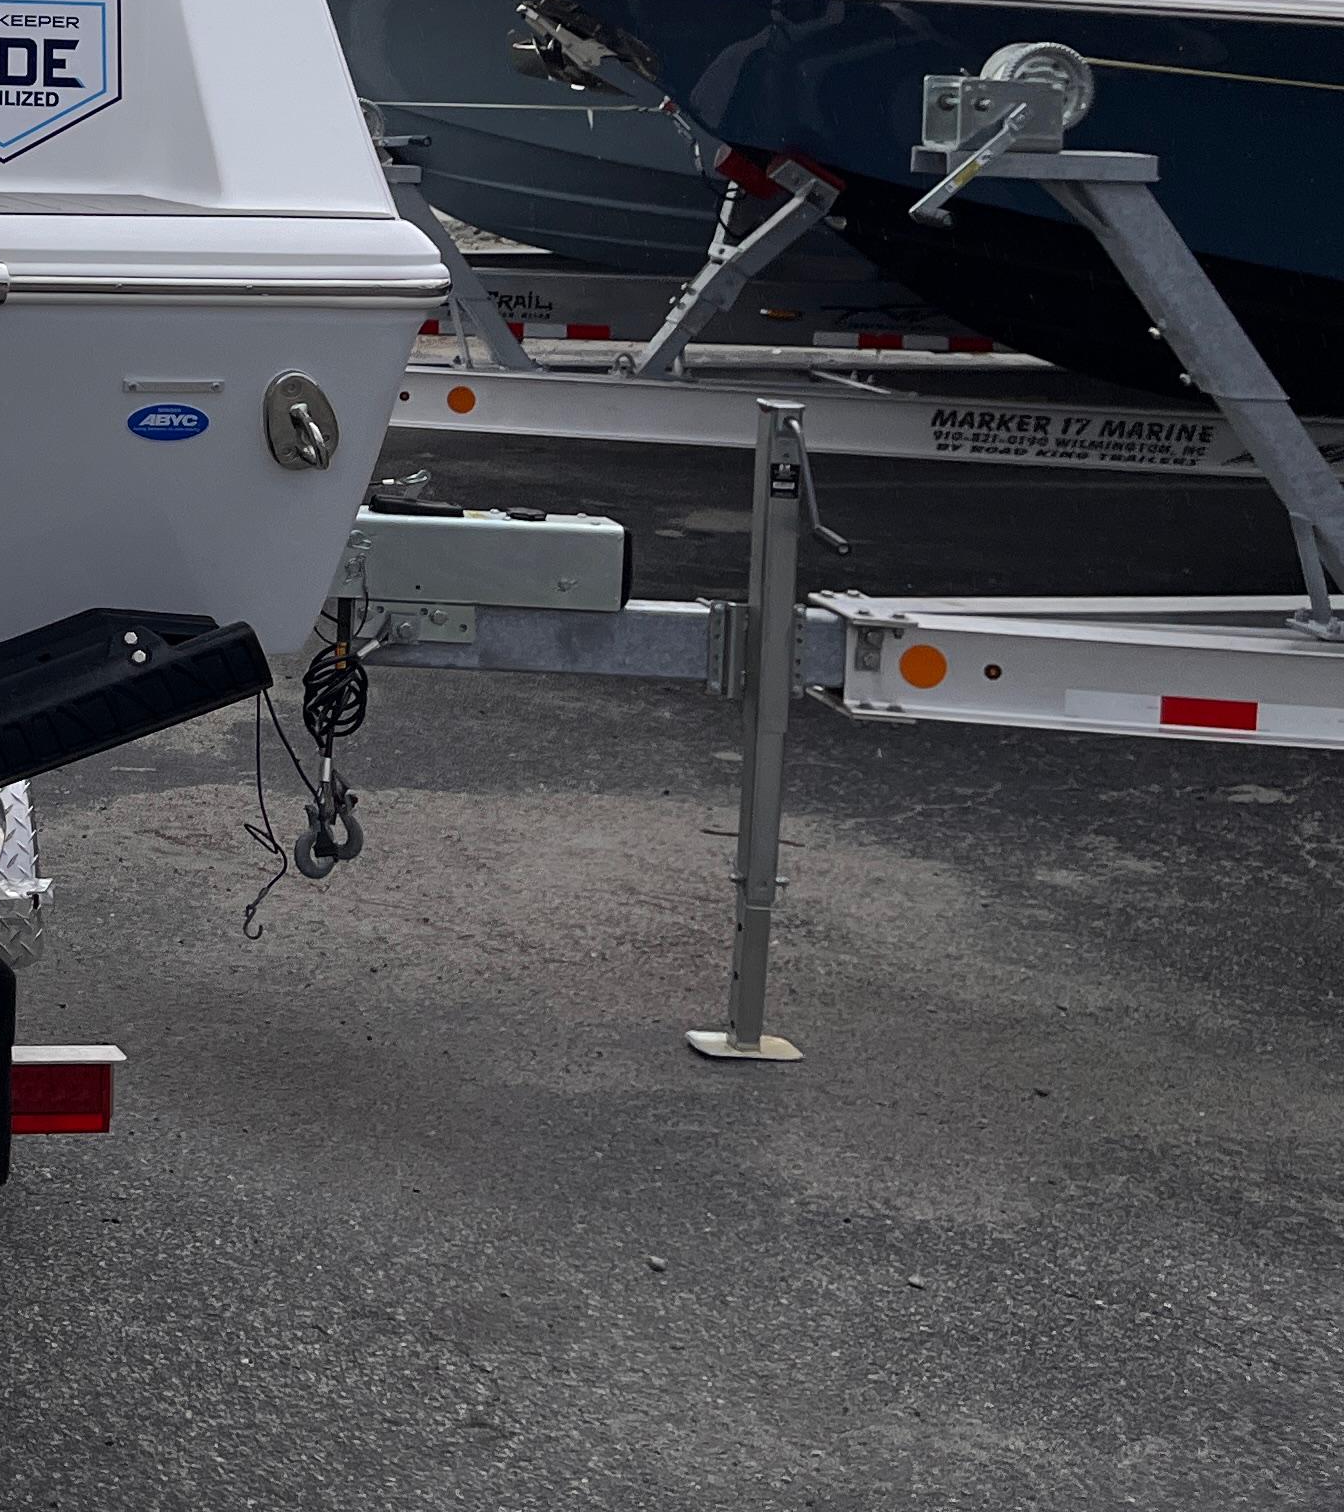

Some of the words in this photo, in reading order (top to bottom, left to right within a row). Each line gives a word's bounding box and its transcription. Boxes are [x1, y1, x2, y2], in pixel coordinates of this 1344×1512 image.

[139, 414, 199, 426] ABYC
[931, 408, 1052, 435] MARKER
[1061, 417, 1092, 435] 17
[1099, 419, 1214, 442] MARINE
